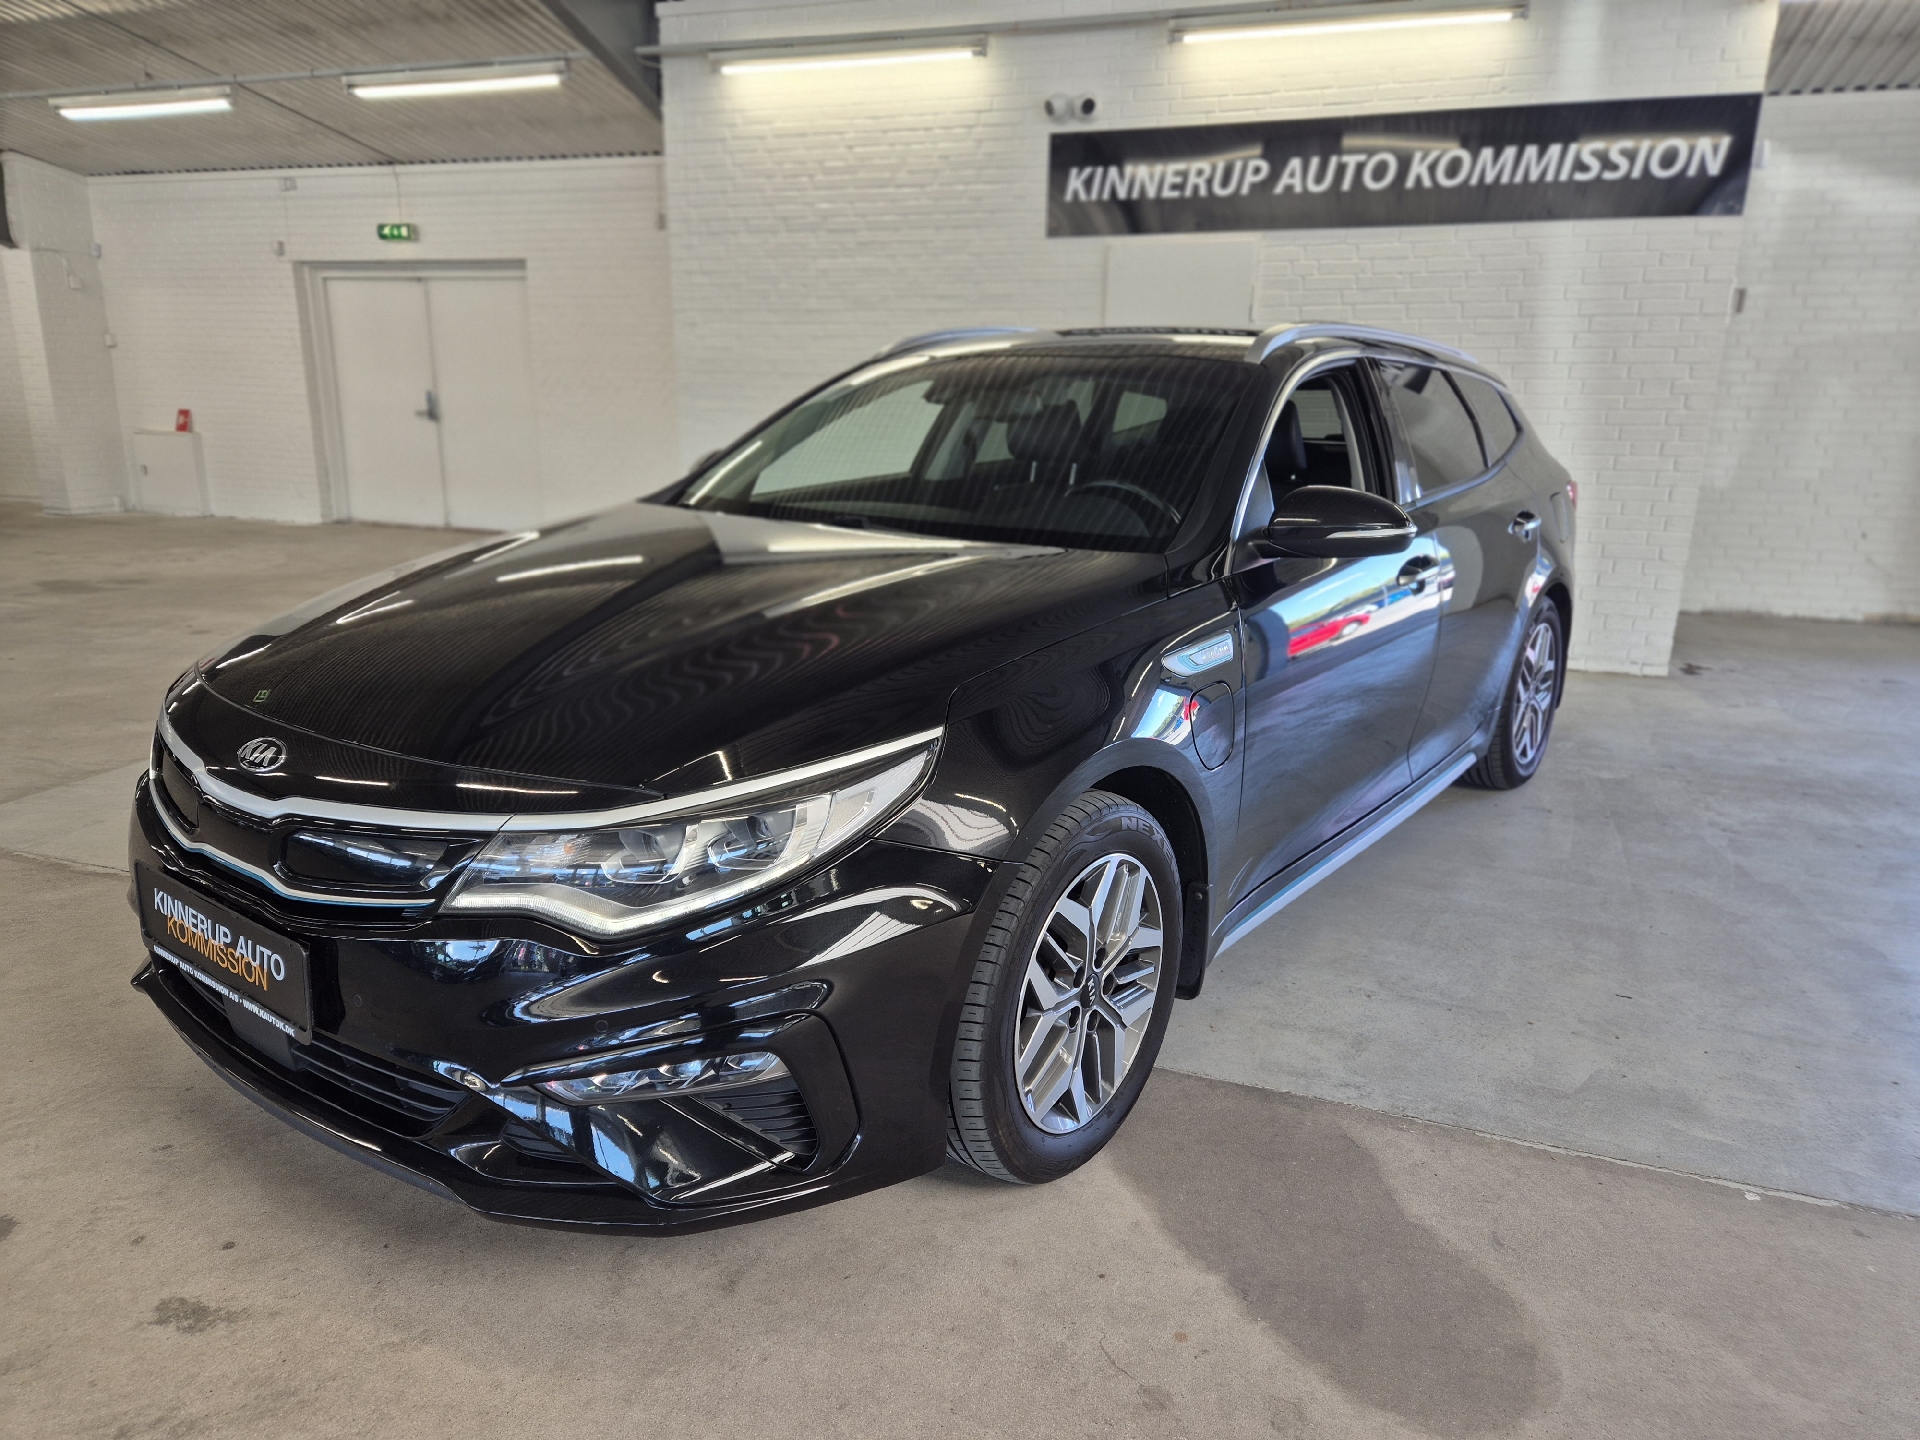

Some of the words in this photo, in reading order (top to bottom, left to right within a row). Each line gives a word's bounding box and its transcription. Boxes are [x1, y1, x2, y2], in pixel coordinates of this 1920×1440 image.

[1064, 157, 1270, 203] KINNERUP
[1274, 150, 1398, 197] AUTO
[1404, 134, 1733, 191] KOMMISSION
[153, 887, 232, 946] KINNERUP
[235, 935, 286, 981] AUTO
[153, 944, 180, 966] KINNERUP
[179, 960, 194, 975] AUTO
[193, 969, 229, 997] KOMMISSION
[167, 914, 268, 992] KOMMISSION
